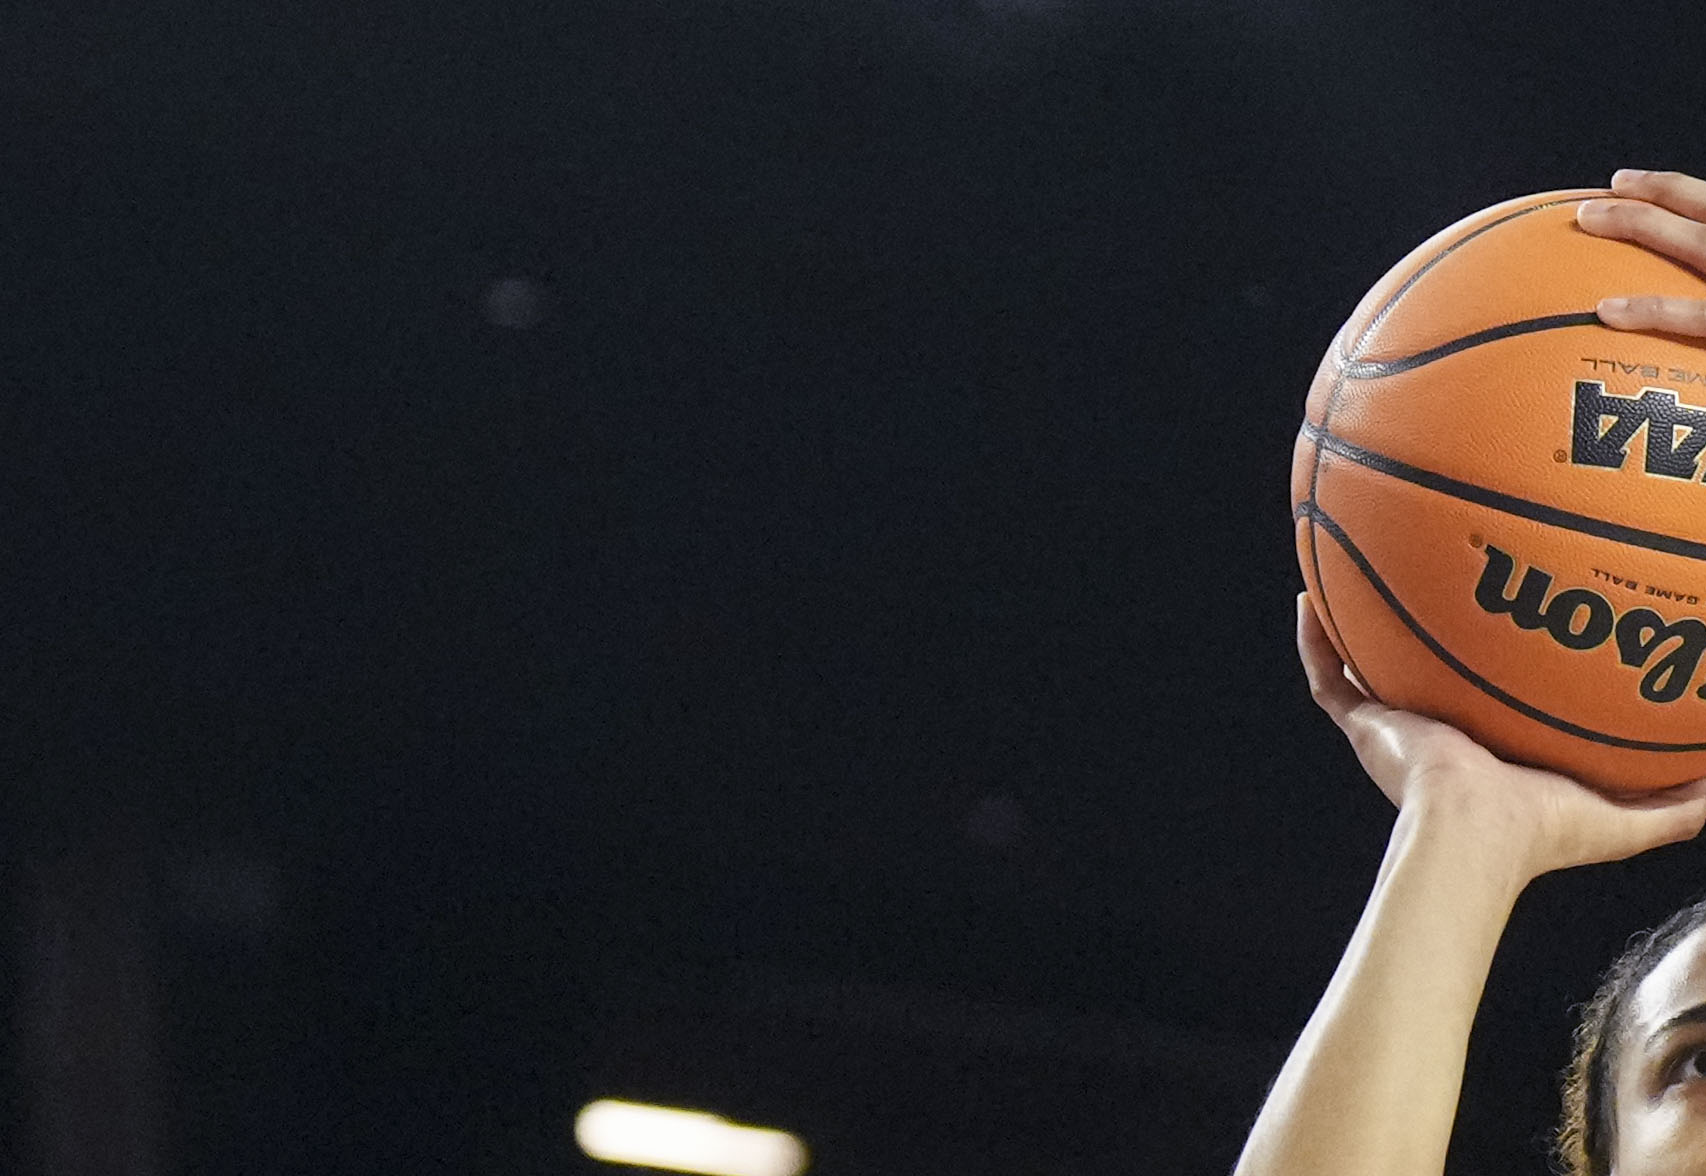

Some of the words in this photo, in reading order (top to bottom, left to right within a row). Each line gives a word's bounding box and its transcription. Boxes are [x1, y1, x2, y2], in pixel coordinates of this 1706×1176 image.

[1580, 356, 1661, 380] BALL
[1589, 567, 1640, 592] BALL
[1645, 584, 1700, 606] GAME
